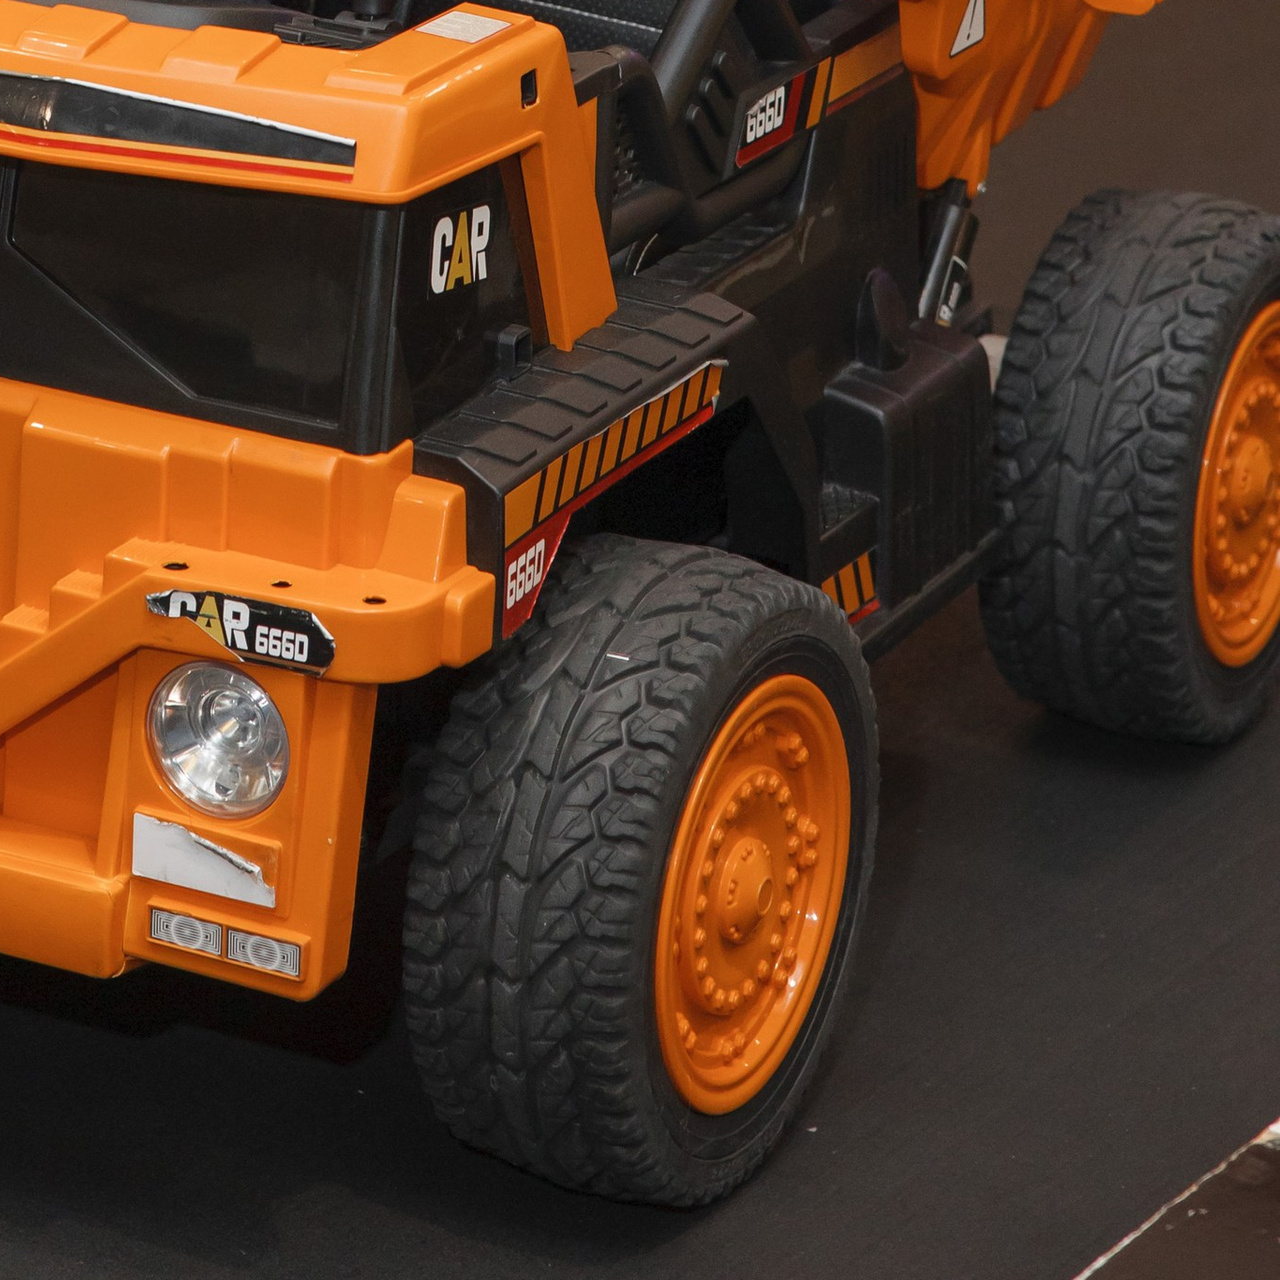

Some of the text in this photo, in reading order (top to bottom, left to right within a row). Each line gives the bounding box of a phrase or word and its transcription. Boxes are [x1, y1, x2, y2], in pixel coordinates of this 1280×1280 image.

[745, 85, 786, 144] 666D
[431, 205, 491, 295] CAR
[506, 538, 546, 610] 666D
[254, 624, 309, 663] 666D
